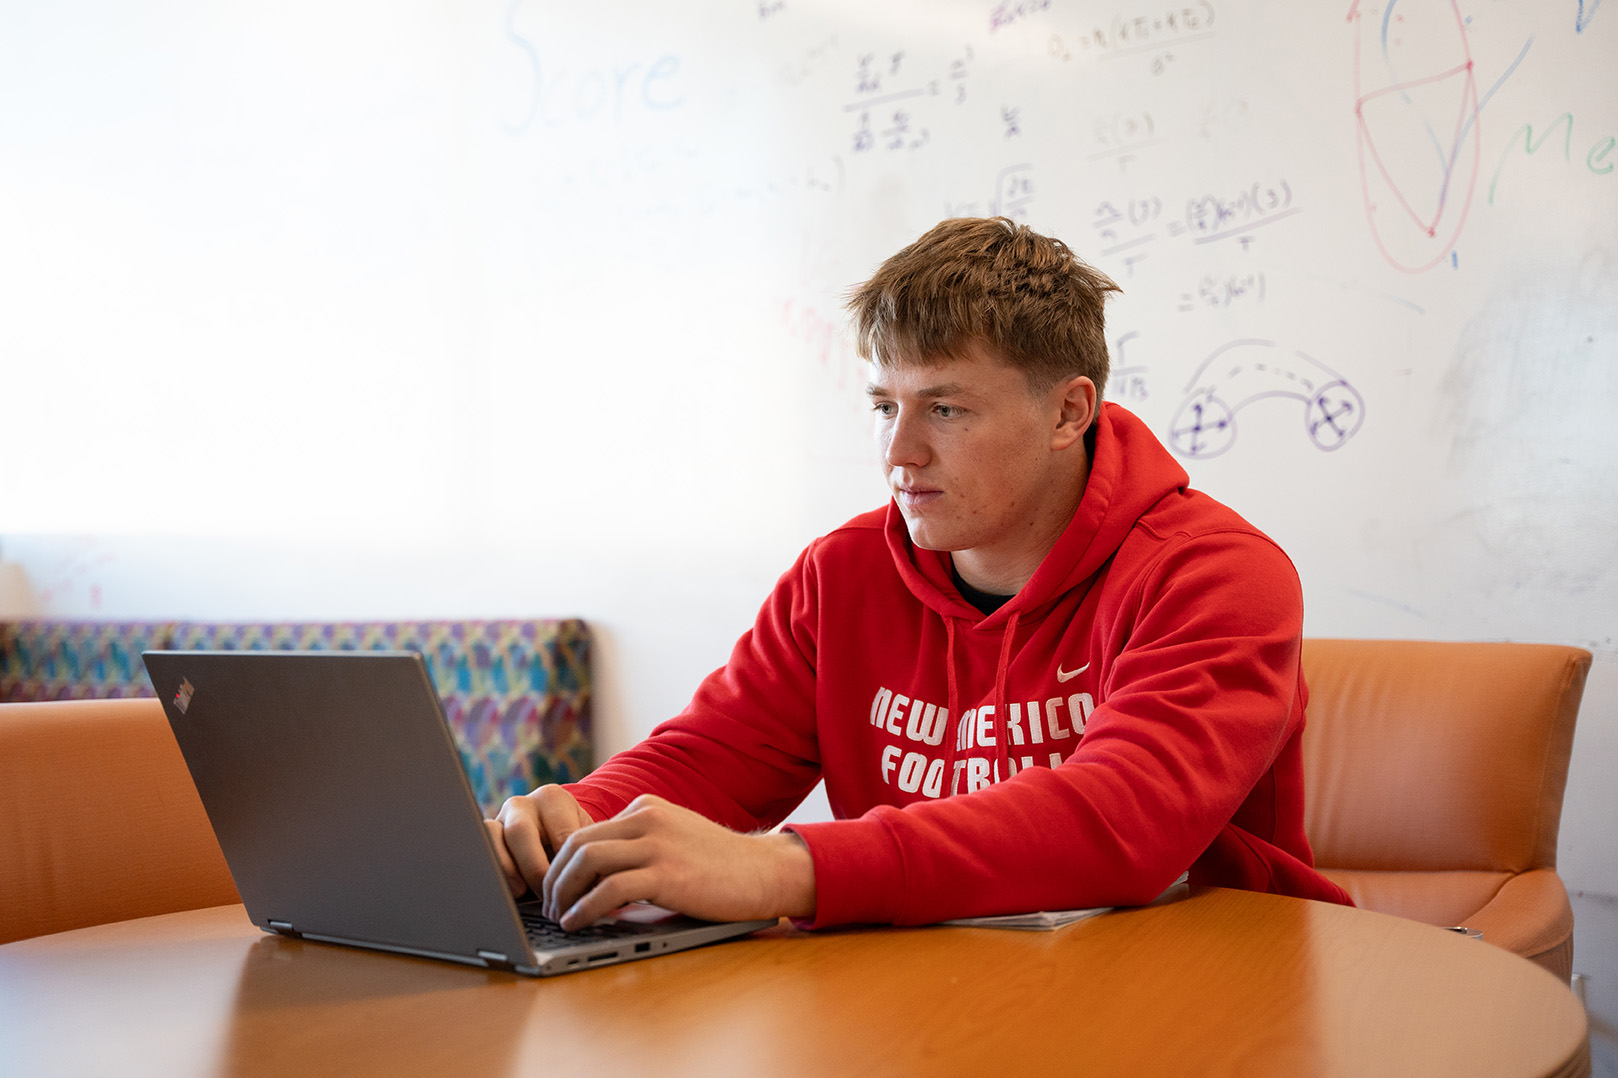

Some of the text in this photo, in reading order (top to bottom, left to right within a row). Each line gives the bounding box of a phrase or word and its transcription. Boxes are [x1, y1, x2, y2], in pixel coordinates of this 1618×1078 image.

[498, 0, 687, 137] Score
[869, 686, 1095, 752] NEW MEXICO
[881, 744, 1063, 799] FOOTB
